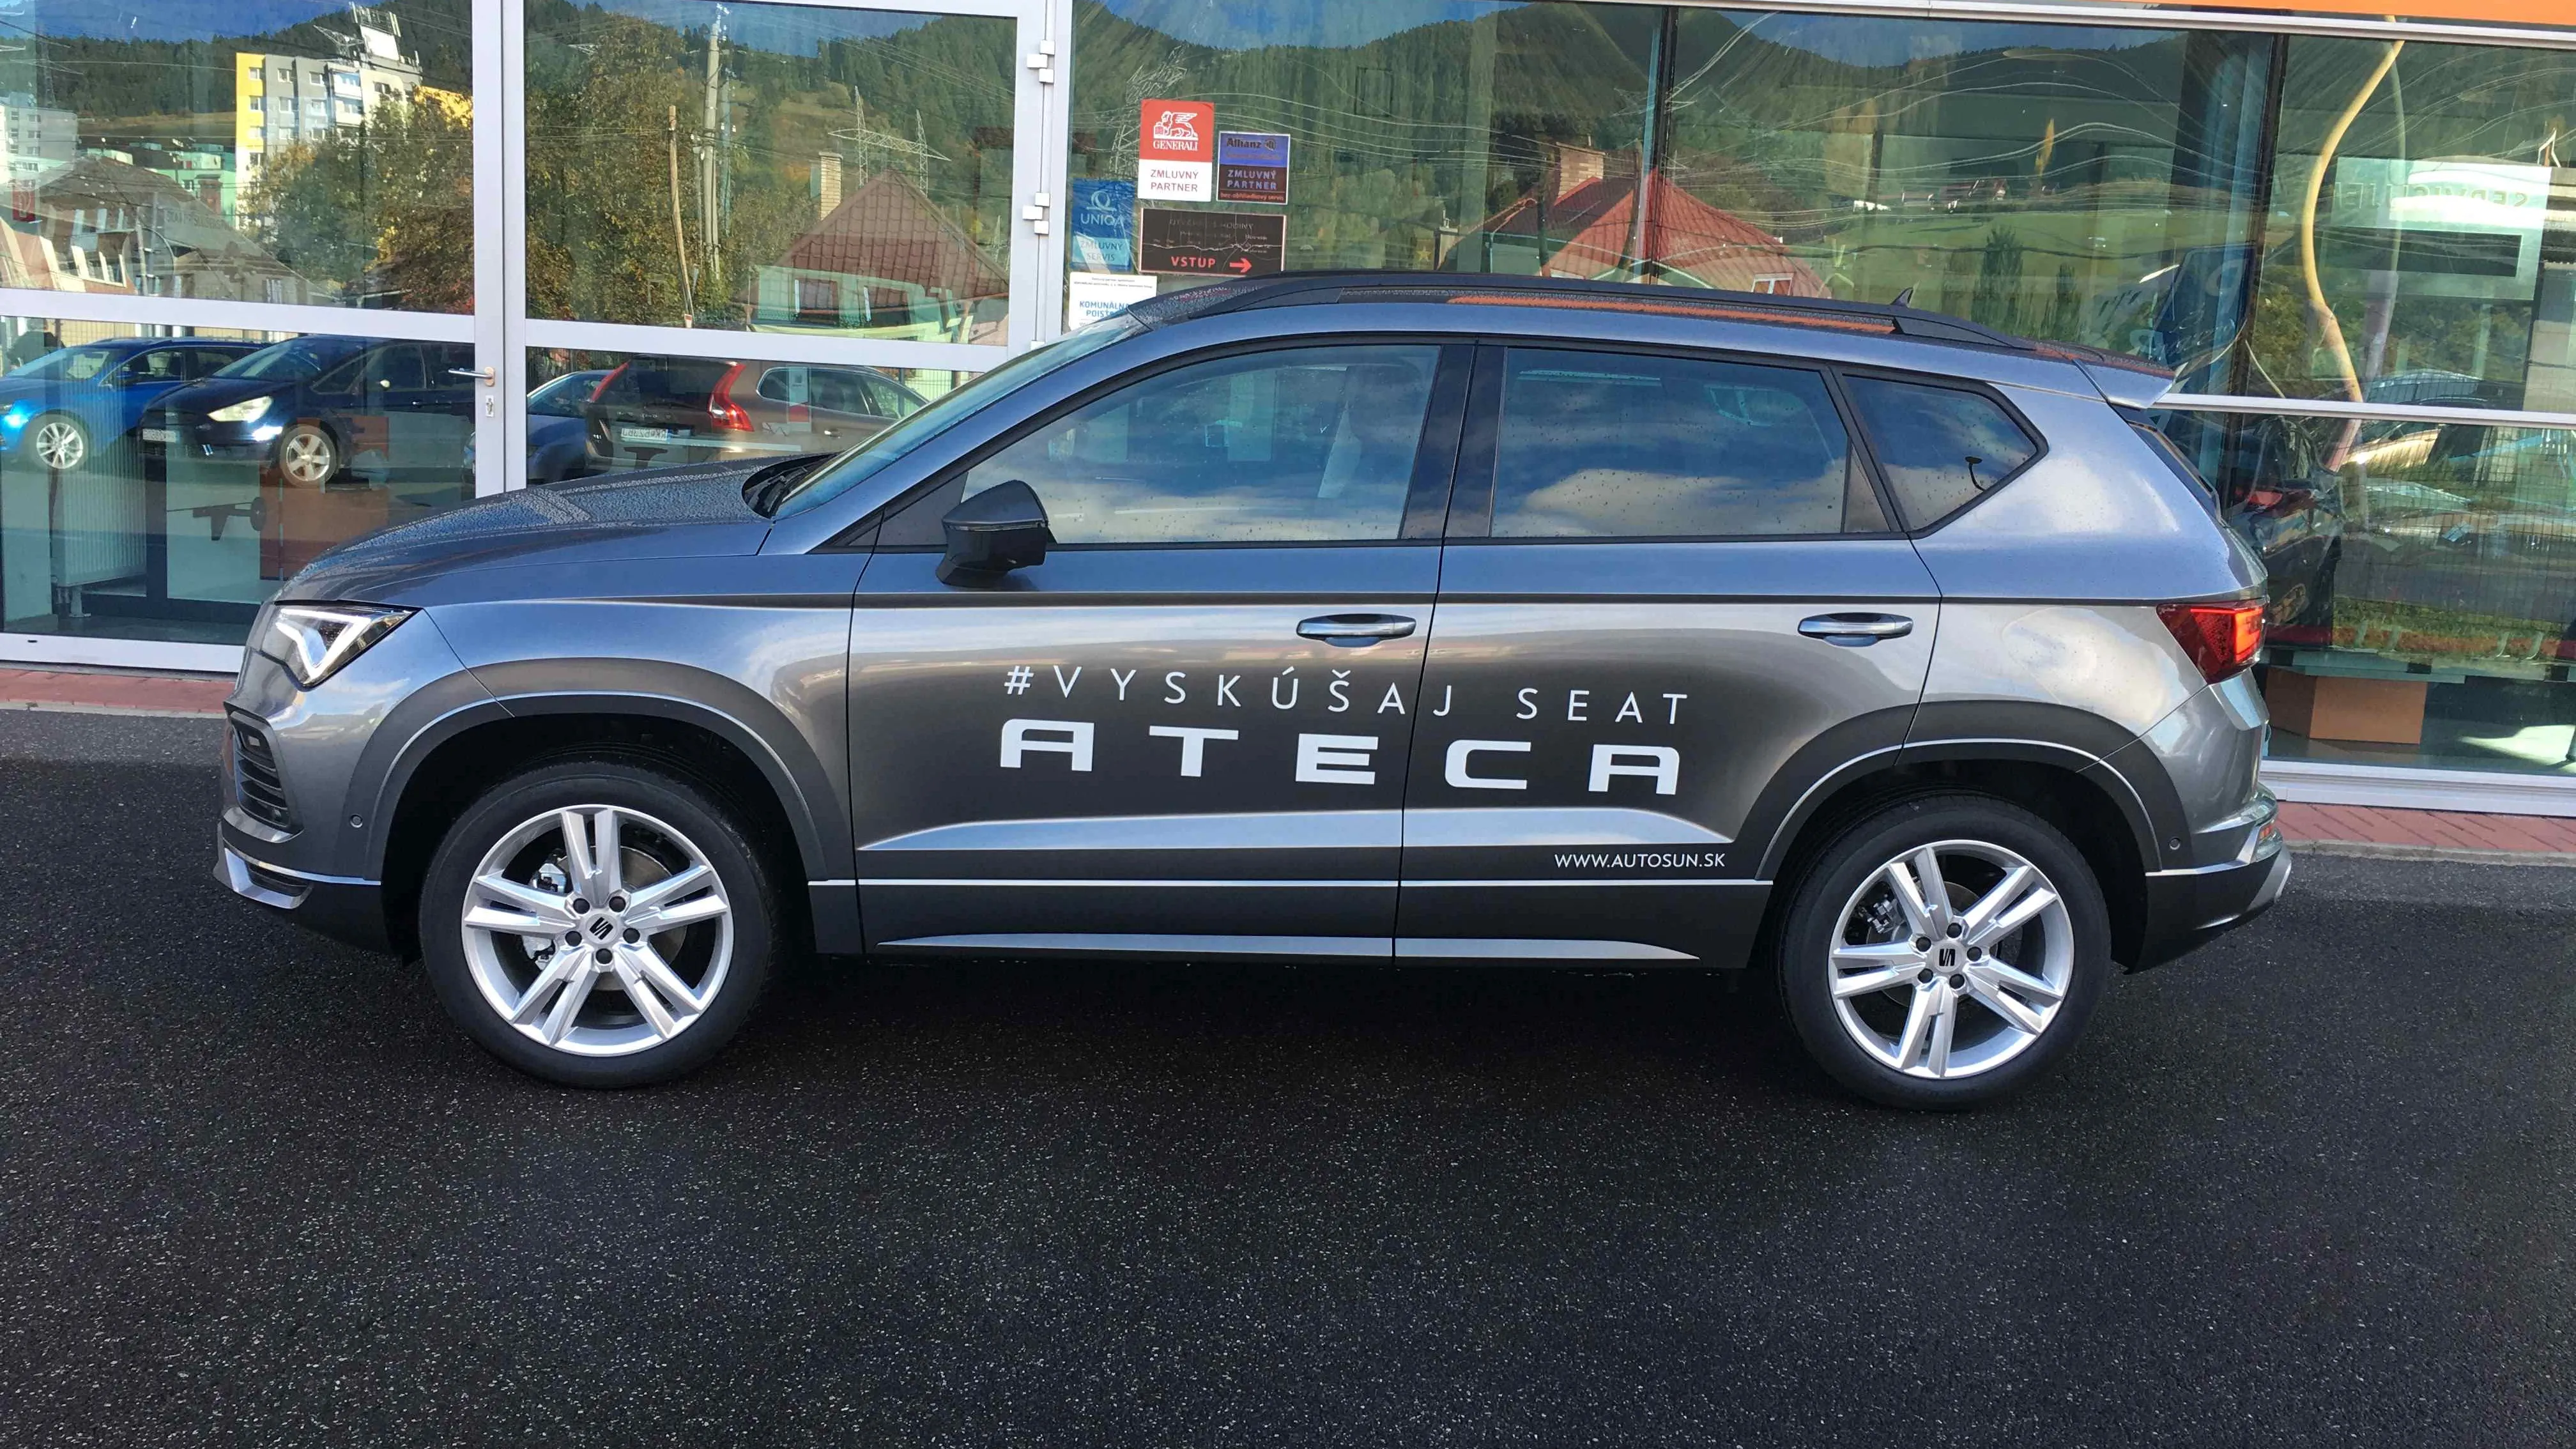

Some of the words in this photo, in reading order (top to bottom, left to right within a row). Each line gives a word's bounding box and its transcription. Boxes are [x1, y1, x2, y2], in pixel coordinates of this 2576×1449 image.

[1153, 140, 1199, 151] GENERALI
[1226, 137, 1262, 148] Allianz
[1151, 167, 1199, 180] ZMLUVNÝ
[1228, 169, 1276, 180] ZMLUVNÝ
[1151, 181, 1198, 192] PARTNER
[1227, 180, 1276, 190] PARTNER
[1080, 213, 1124, 227] UNIQA
[1086, 252, 1115, 261] SERVIS
[1170, 256, 1216, 268] VSTUP
[1004, 665, 1452, 717] #VYSKÚŠAJ
[1516, 687, 1687, 724] SEAT
[1000, 718, 1680, 795] ATECA
[1554, 852, 1726, 868] WWW.AUTOSUN.SK
